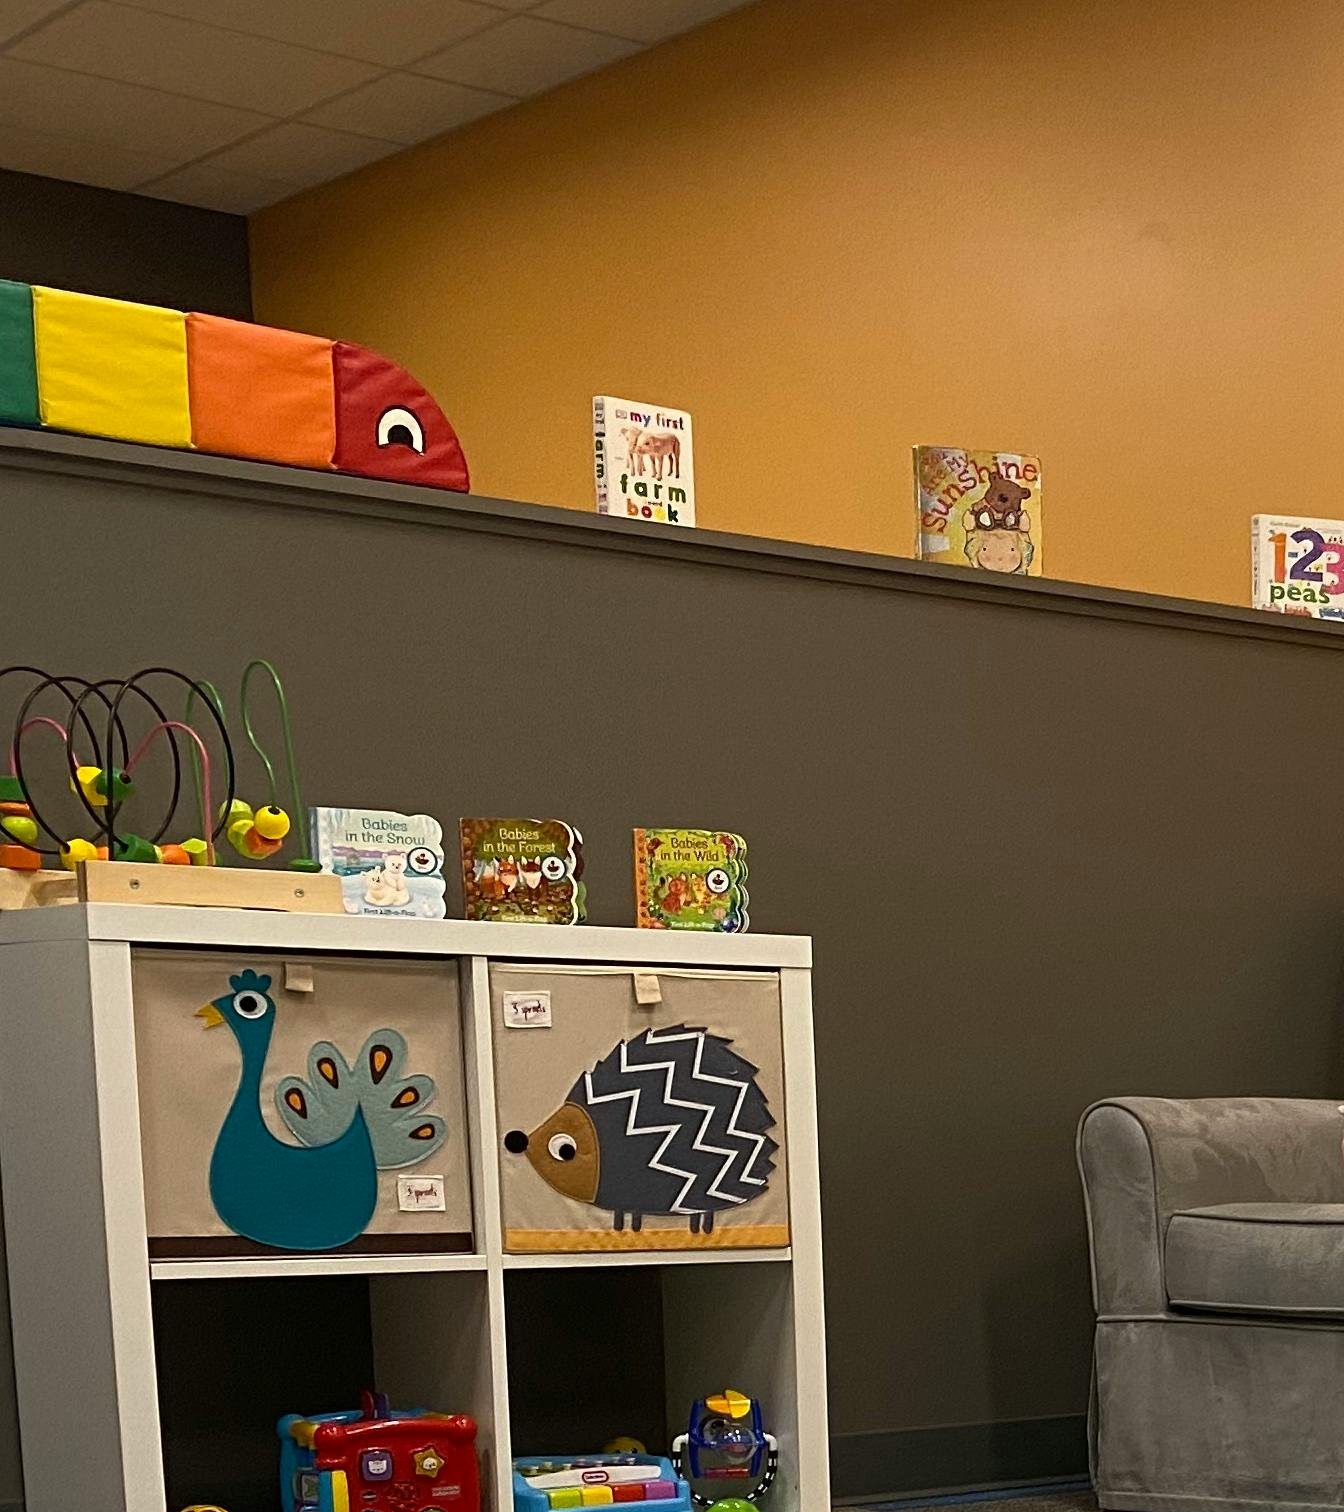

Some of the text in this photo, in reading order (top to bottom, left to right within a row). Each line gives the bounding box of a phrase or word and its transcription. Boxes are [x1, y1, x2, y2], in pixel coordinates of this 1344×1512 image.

[630, 411, 684, 430] my first
[620, 473, 687, 503] farm
[922, 455, 1038, 533] Sunshine
[627, 498, 679, 523] book
[1270, 584, 1330, 604] peas
[361, 817, 409, 832] Babies
[345, 830, 426, 846] in the Snow
[499, 828, 540, 841] Babies
[483, 841, 556, 854] in the Forest
[670, 837, 709, 850] Babies
[661, 849, 720, 862] in the Wild
